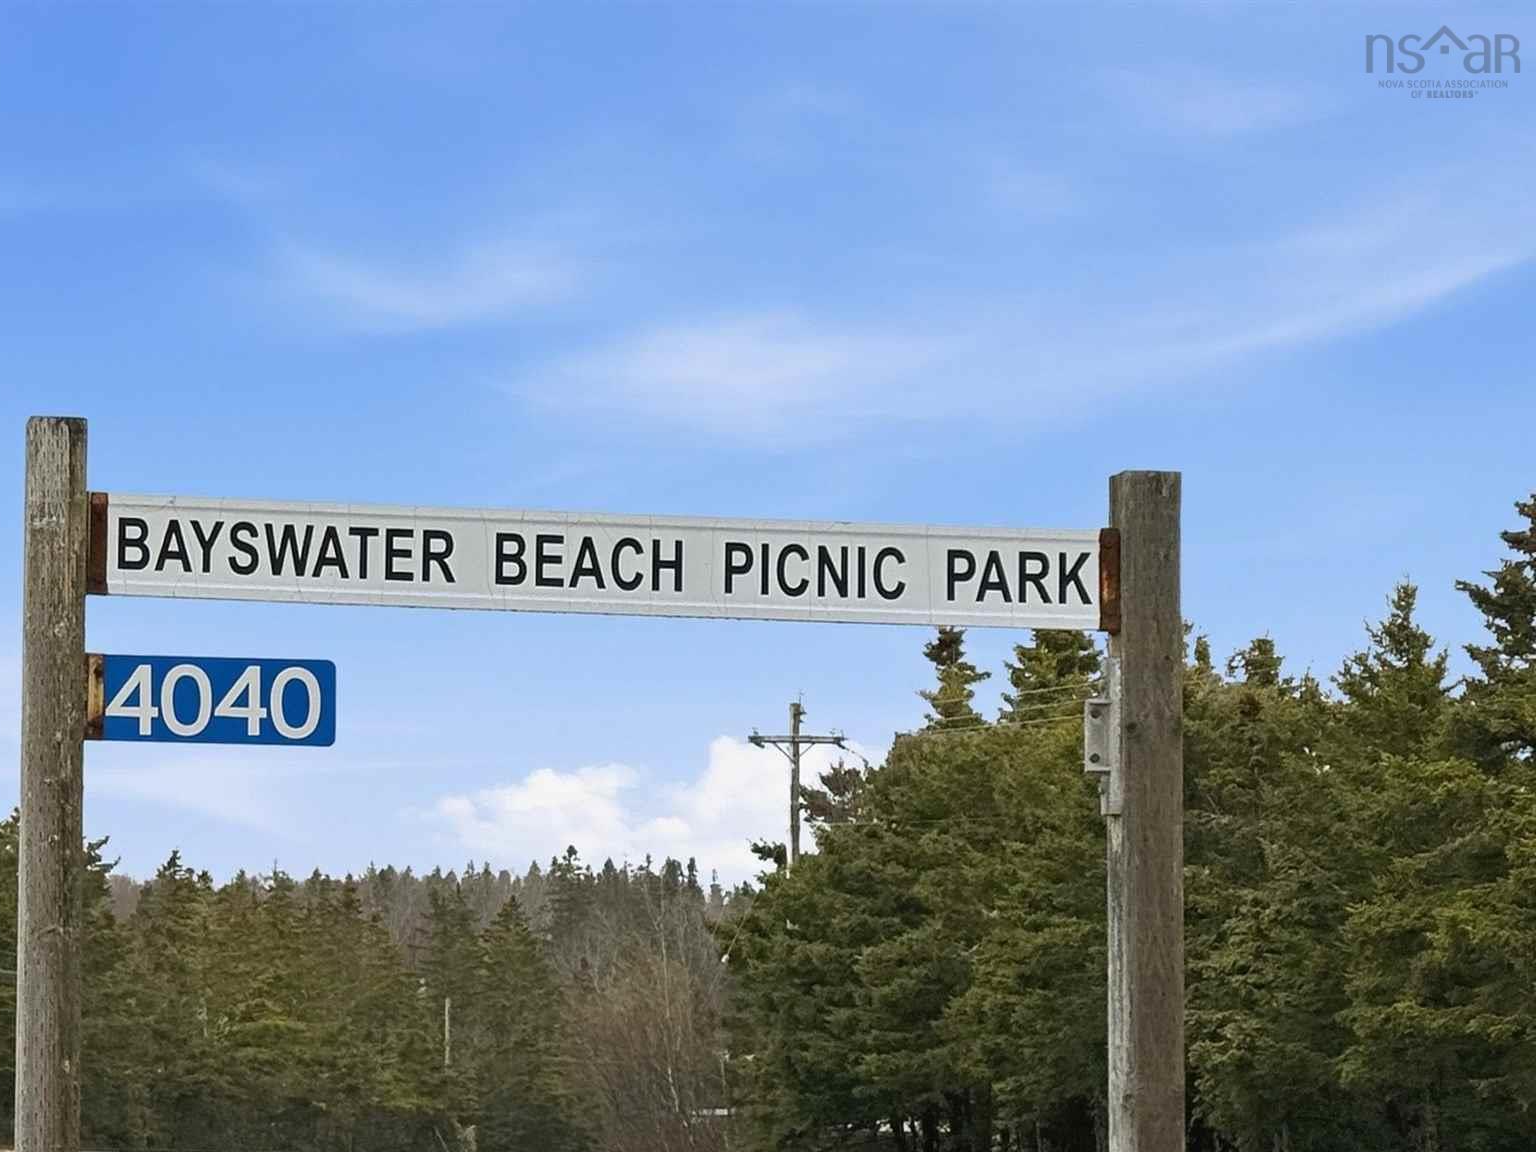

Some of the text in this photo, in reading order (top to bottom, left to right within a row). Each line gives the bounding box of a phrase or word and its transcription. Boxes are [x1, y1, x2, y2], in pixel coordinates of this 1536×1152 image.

[116, 516, 1093, 605] BAYSWATER BEACH PICNIC PARK
[105, 664, 322, 740] 4040
